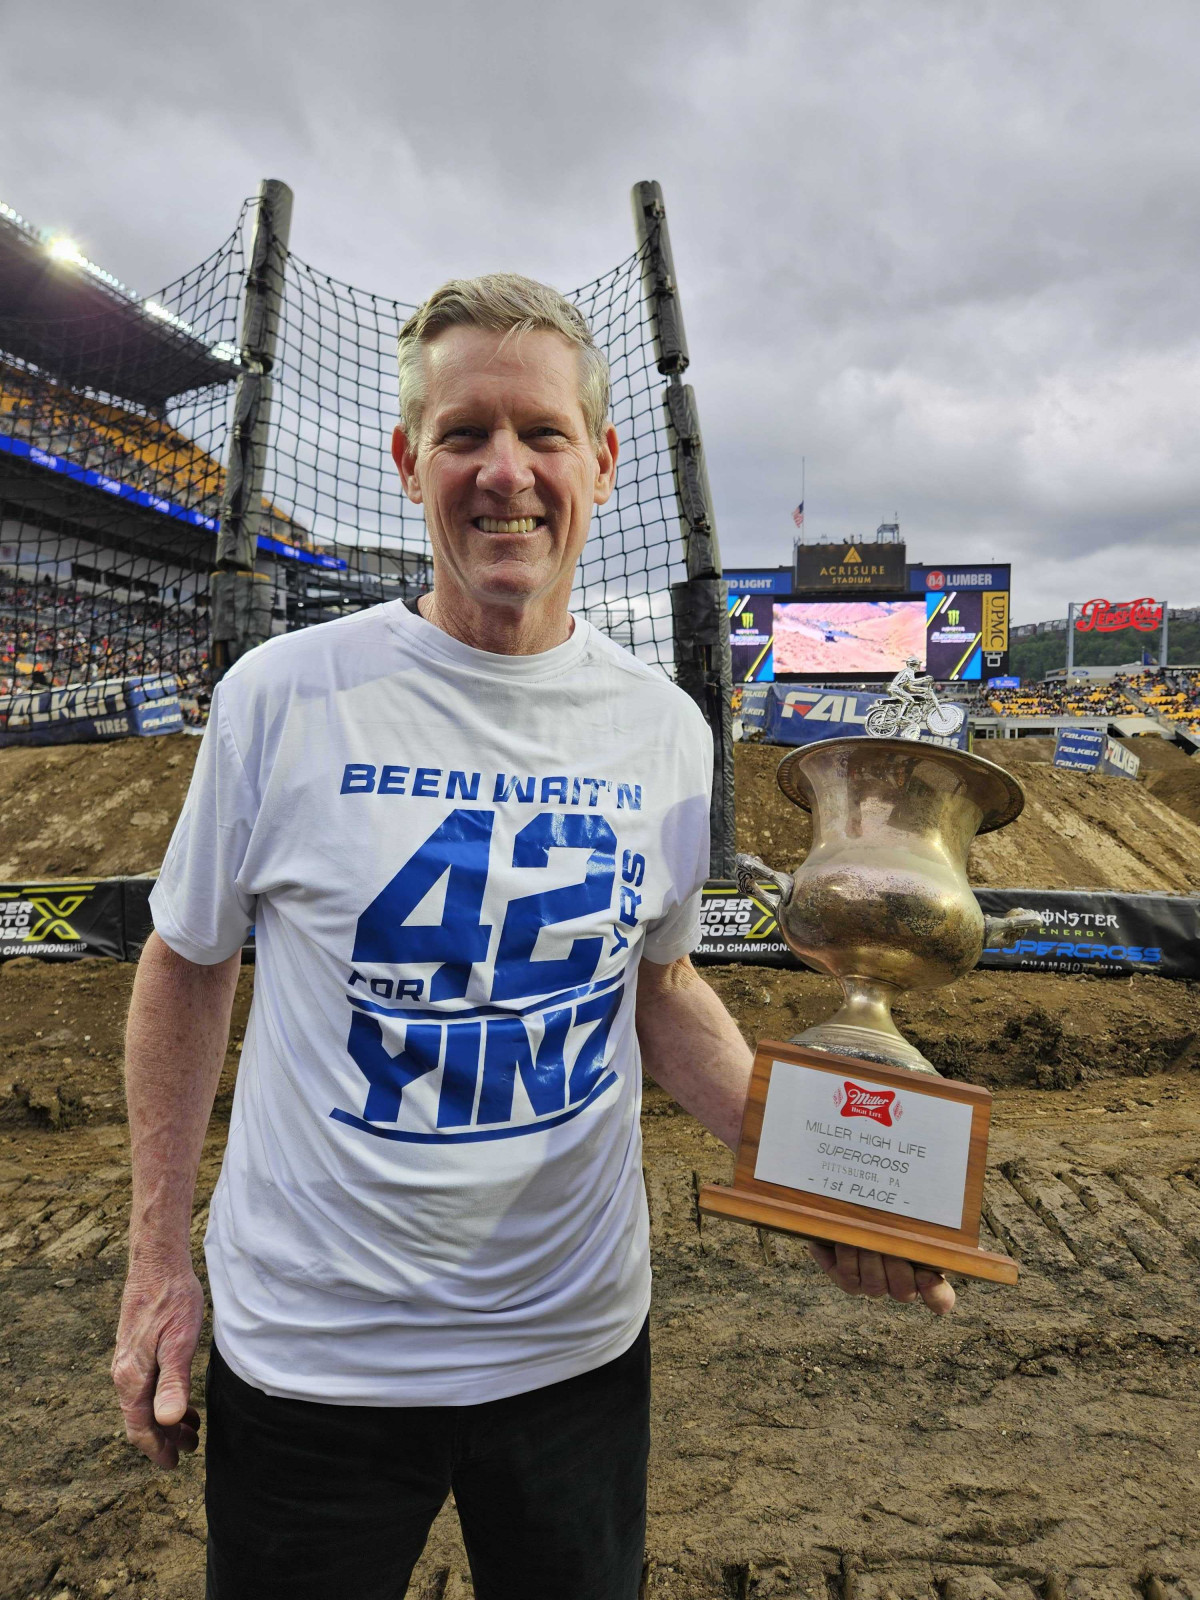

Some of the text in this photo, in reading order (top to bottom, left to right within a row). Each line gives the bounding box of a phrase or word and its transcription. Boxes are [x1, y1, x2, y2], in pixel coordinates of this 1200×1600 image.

[820, 565, 885, 577] ACRISURE
[946, 573, 993, 586] LUMBER
[739, 579, 772, 589] LIGHT
[832, 576, 872, 584] STADIUM
[990, 595, 1005, 648] UPMC
[93, 717, 129, 735] TIRES
[1061, 732, 1103, 743] FALKEN
[1058, 745, 1100, 757] FALKEN
[1055, 759, 1096, 771] FALKEN
[340, 763, 642, 811] BEEN WAIT'N
[351, 808, 618, 1003] 42
[609, 848, 646, 958] YRS
[1040, 908, 1120, 929] ONSTER
[1039, 927, 1106, 938] ENERGY
[3, 942, 88, 956] CHAMPIONSHIP
[694, 944, 725, 954] ORLD
[982, 939, 1162, 963] UPERCROSS
[346, 981, 625, 1129] YINZ
[848, 1088, 890, 1105] Miller
[805, 1119, 927, 1159] MILLER HIGH LIFE
[816, 1142, 910, 1174] SUPERCROSS
[822, 1176, 842, 1193] 1st
[849, 1184, 898, 1205] PLACE
[888, 1177, 901, 1188] PA
